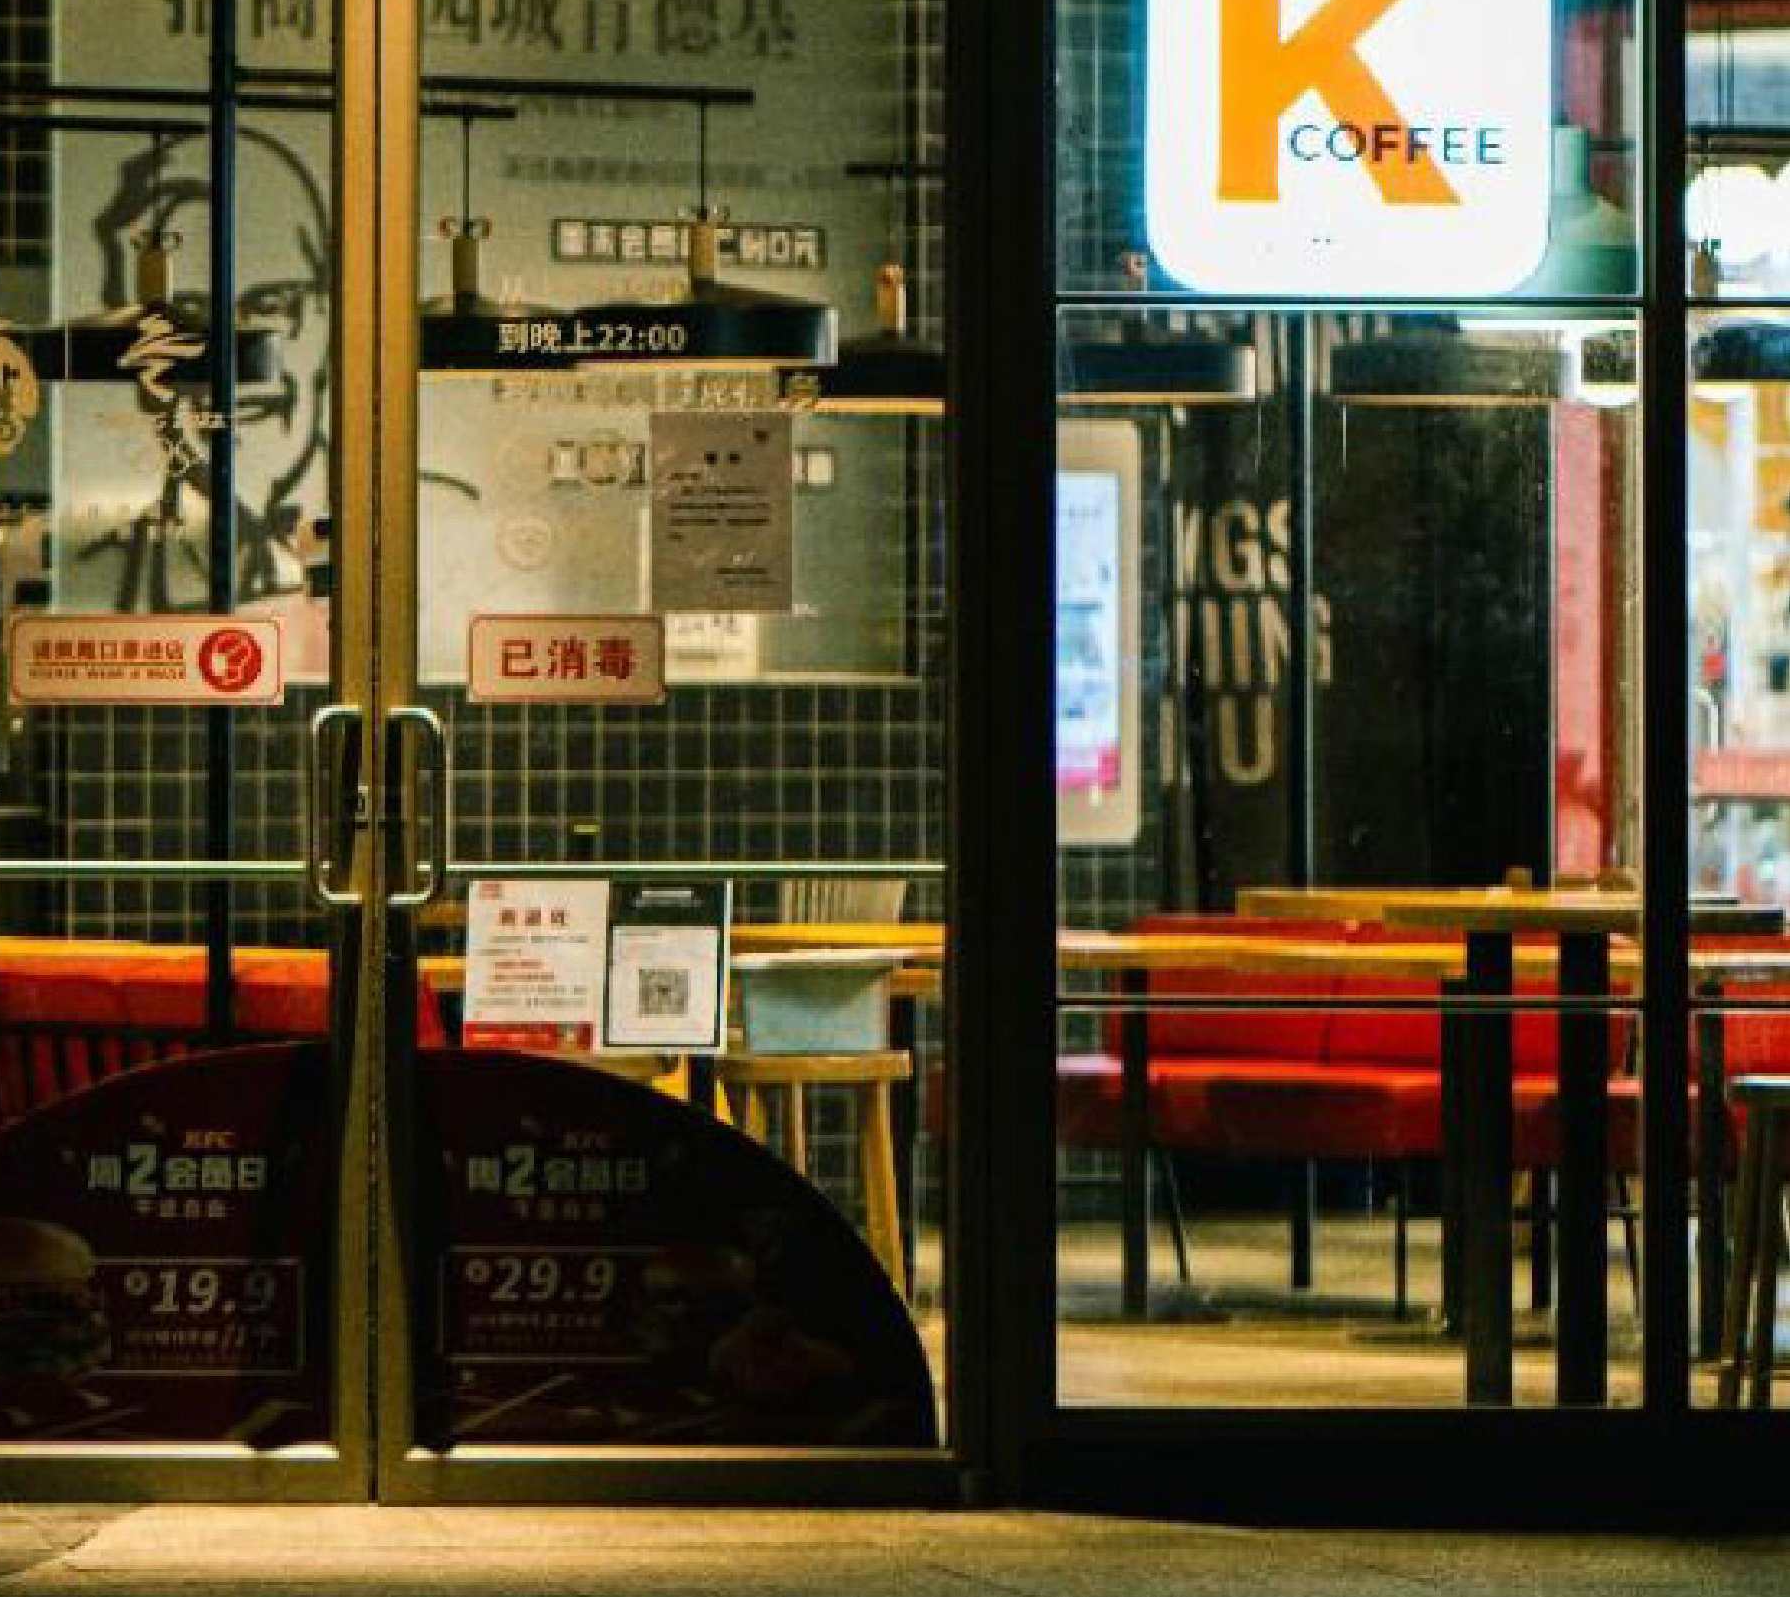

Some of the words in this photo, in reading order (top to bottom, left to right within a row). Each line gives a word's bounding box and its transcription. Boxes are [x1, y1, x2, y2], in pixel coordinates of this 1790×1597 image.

[1287, 122, 1508, 166] COFFEE
[497, 321, 688, 355] 到晚上22:00
[499, 637, 638, 681] 已消毒
